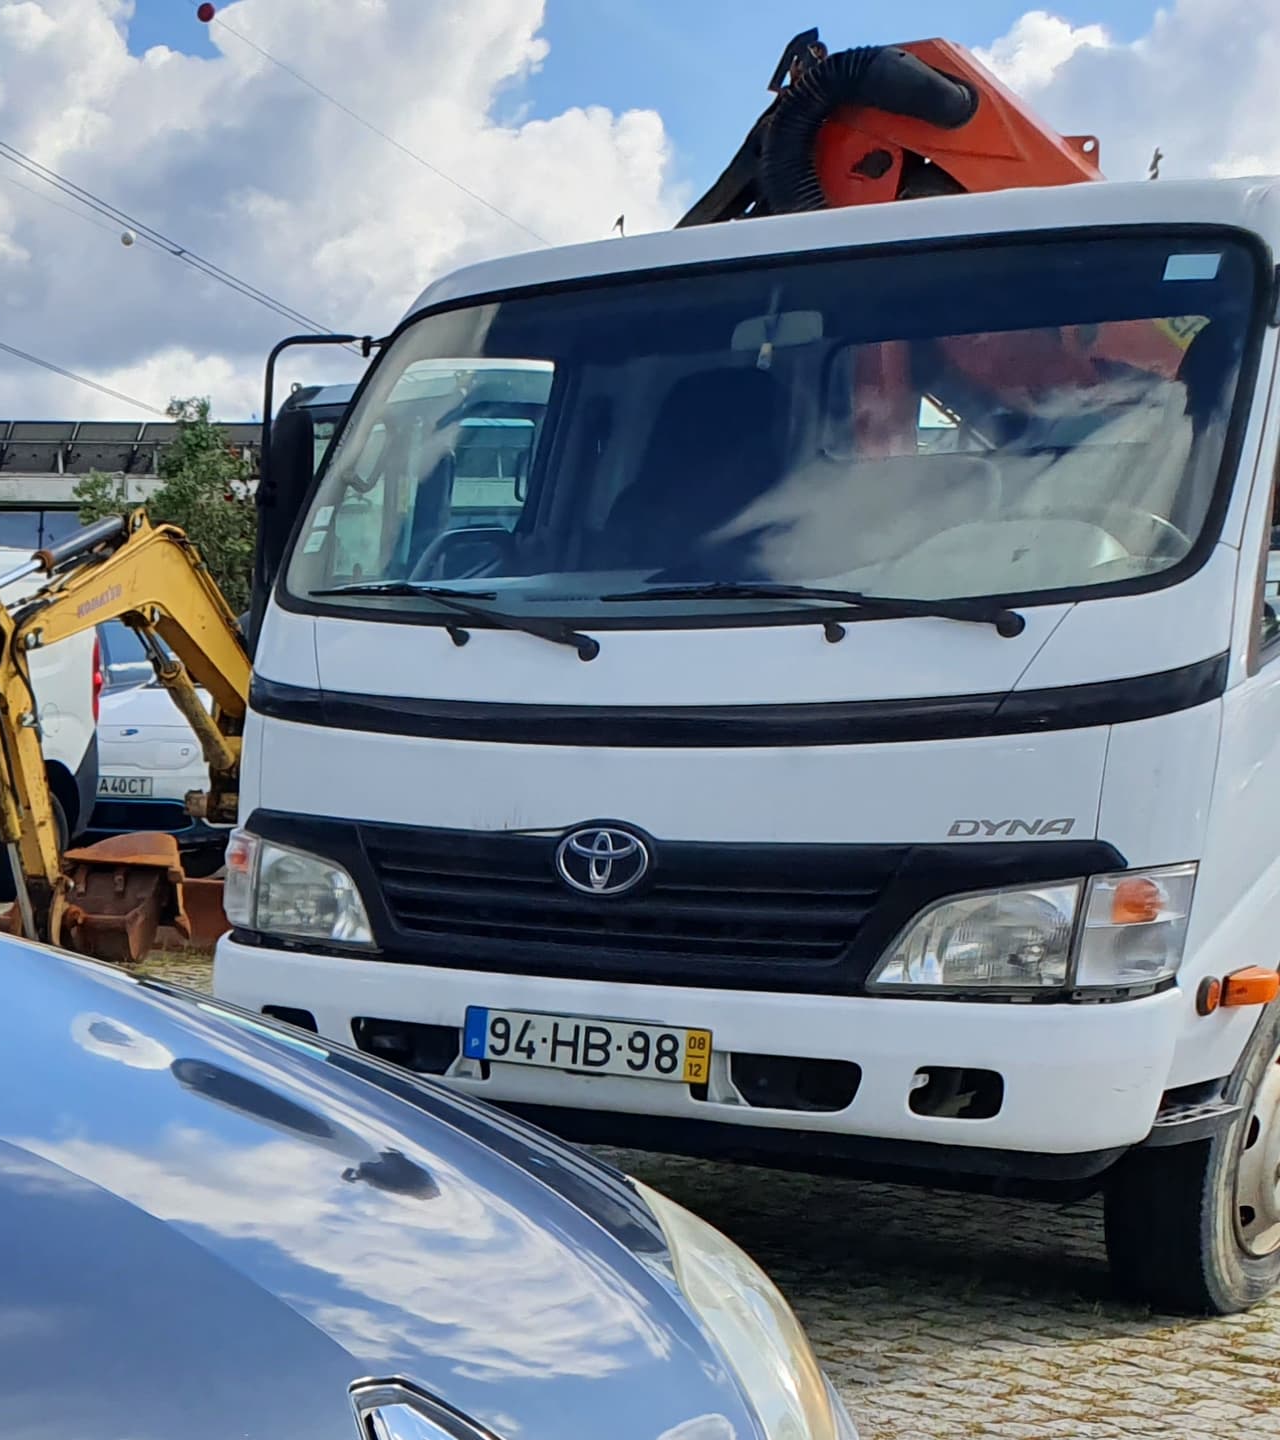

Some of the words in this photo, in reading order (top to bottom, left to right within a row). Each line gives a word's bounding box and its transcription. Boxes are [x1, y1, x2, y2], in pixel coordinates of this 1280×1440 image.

[947, 818, 1075, 836] DYNA
[688, 1036, 706, 1050] 08
[688, 1063, 702, 1077] 12
